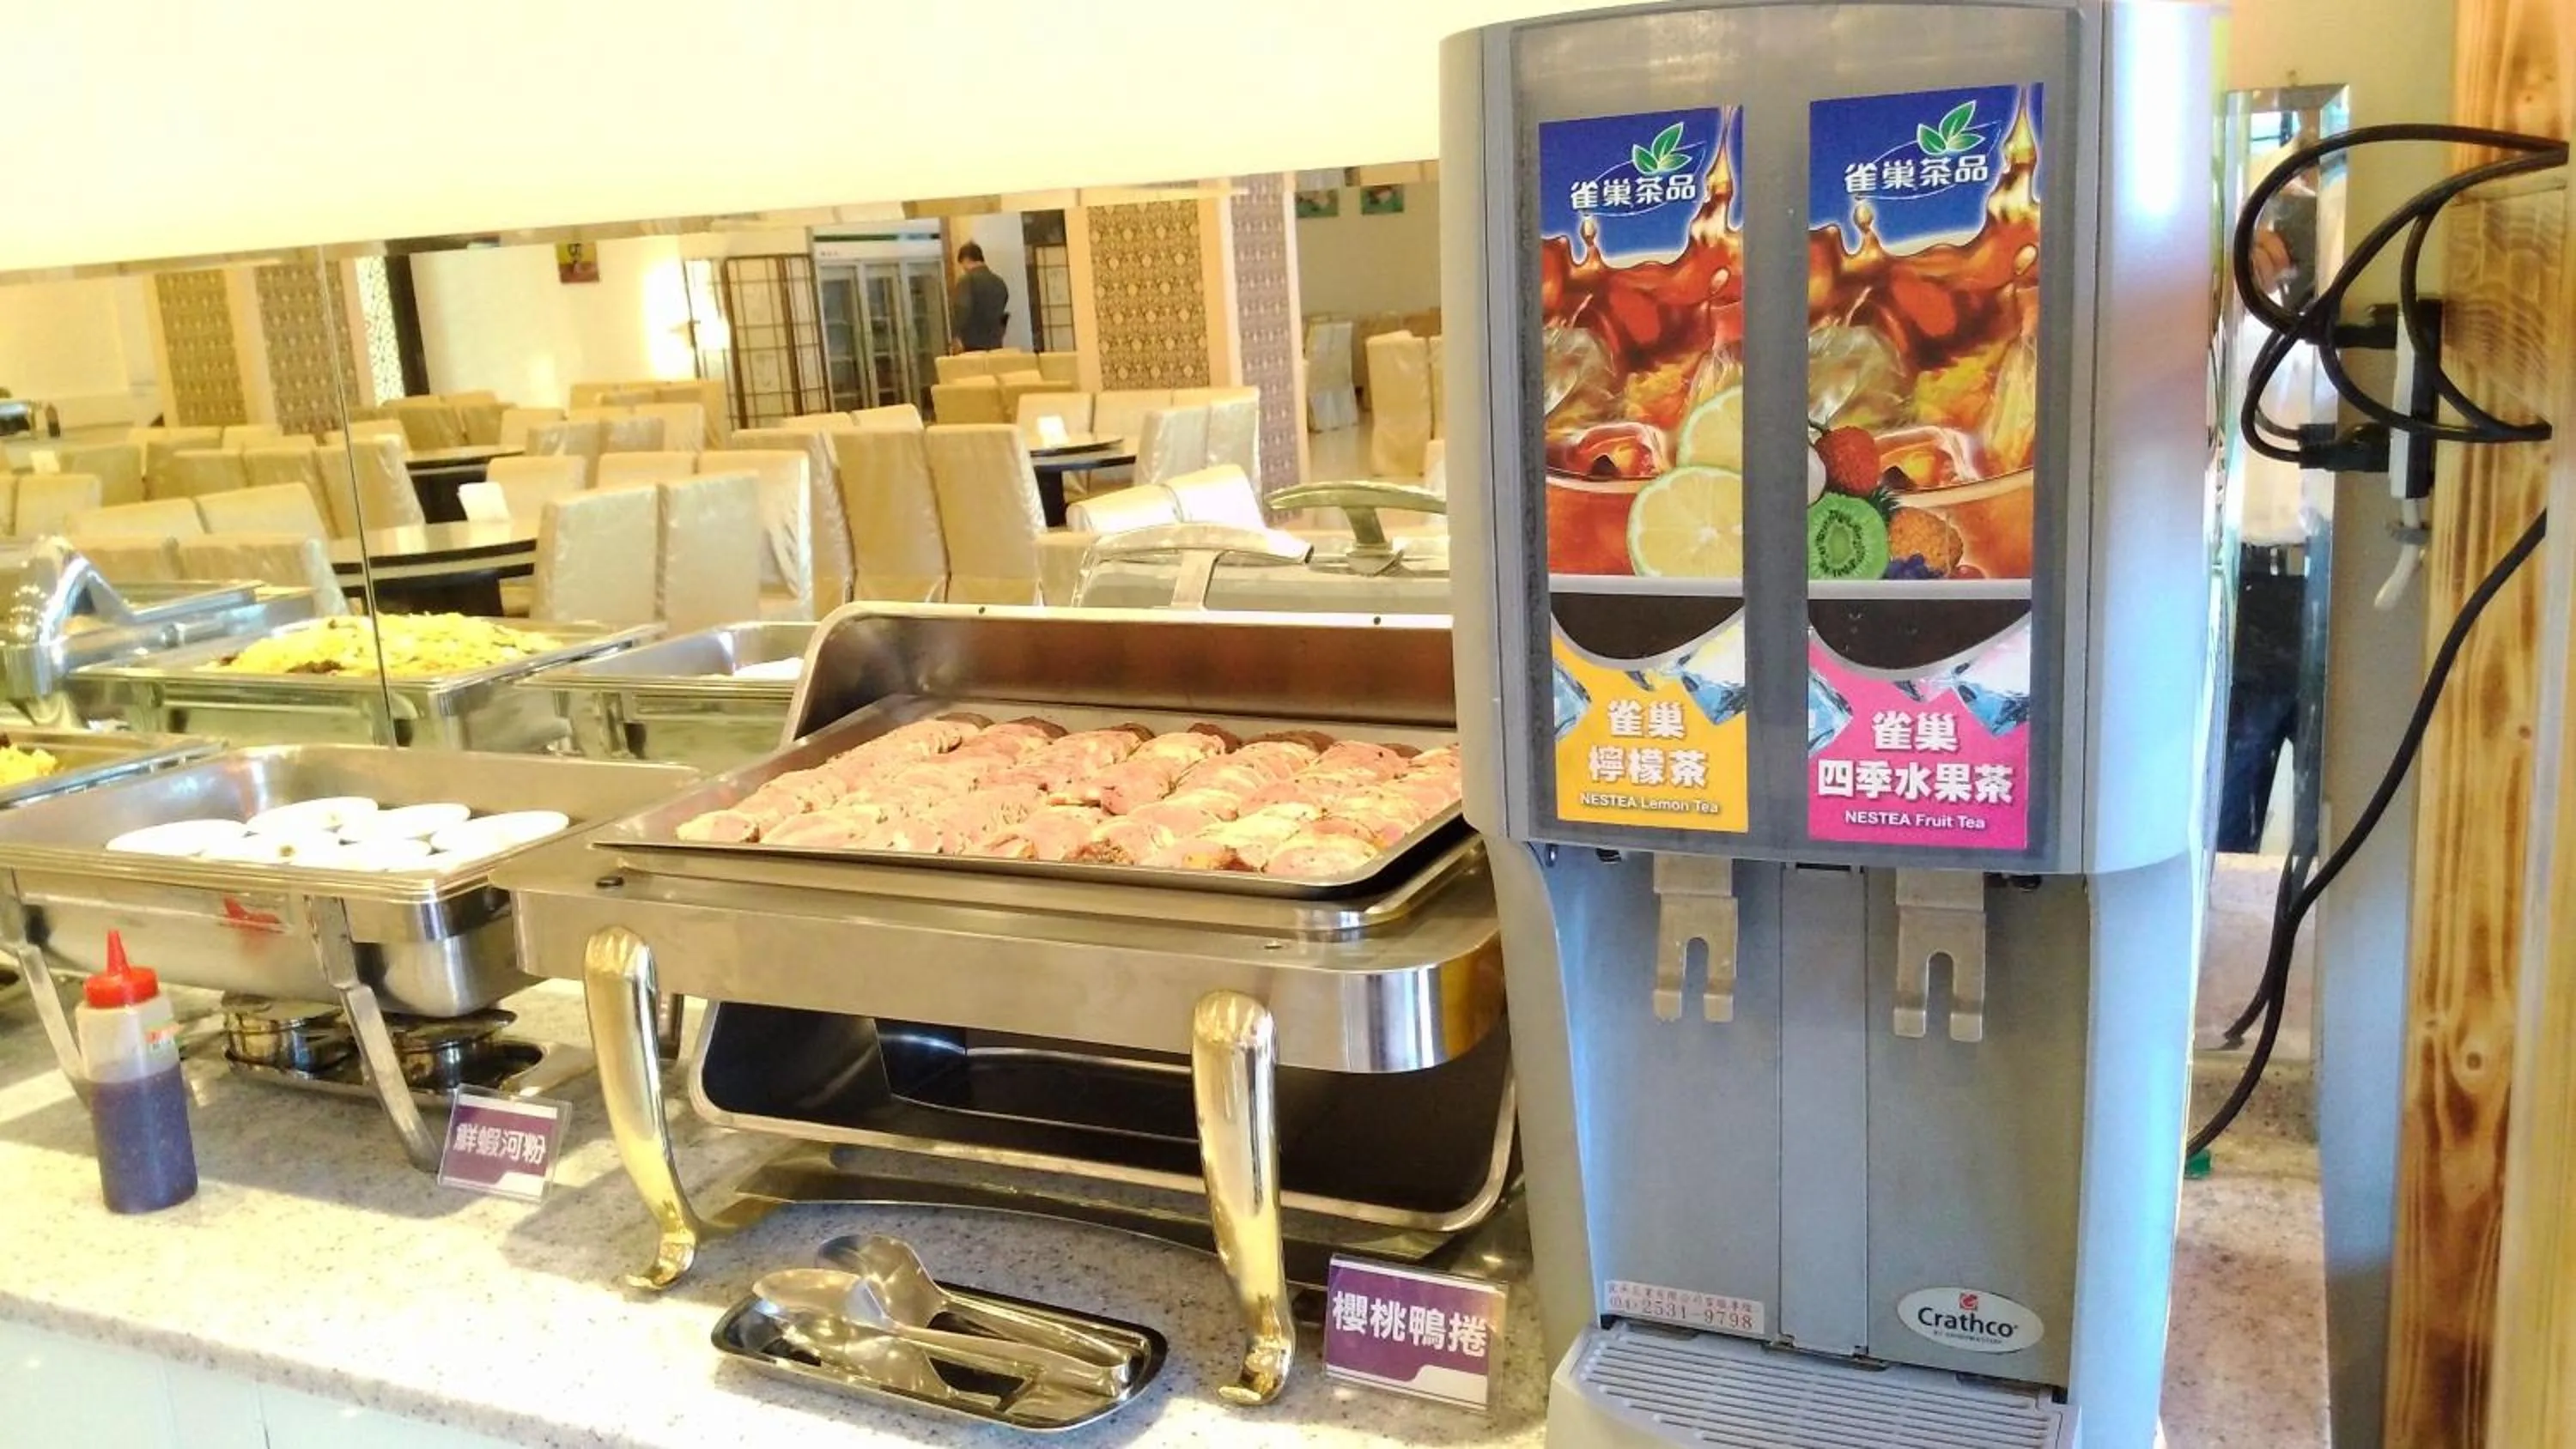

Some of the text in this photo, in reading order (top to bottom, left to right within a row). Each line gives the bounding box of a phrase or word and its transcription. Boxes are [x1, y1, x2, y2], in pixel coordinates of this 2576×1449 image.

[1570, 173, 1697, 211] 雀巢茶品
[1843, 153, 1990, 194] 雀巢茶品
[1607, 699, 1686, 739] 雀巢
[1872, 709, 1959, 753] 雀巢
[1589, 744, 1708, 788] 檸檬茶
[1818, 759, 2014, 803] 四季水果茶
[1580, 791, 1719, 813] NESTEA Lemon Tea
[1844, 810, 1985, 829] NESTEA Fruit Tea
[453, 1122, 546, 1165] 鮮蝦河粉
[1333, 1290, 1487, 1357] 櫻桃鴨捲
[1917, 1307, 2014, 1337] Crathco
